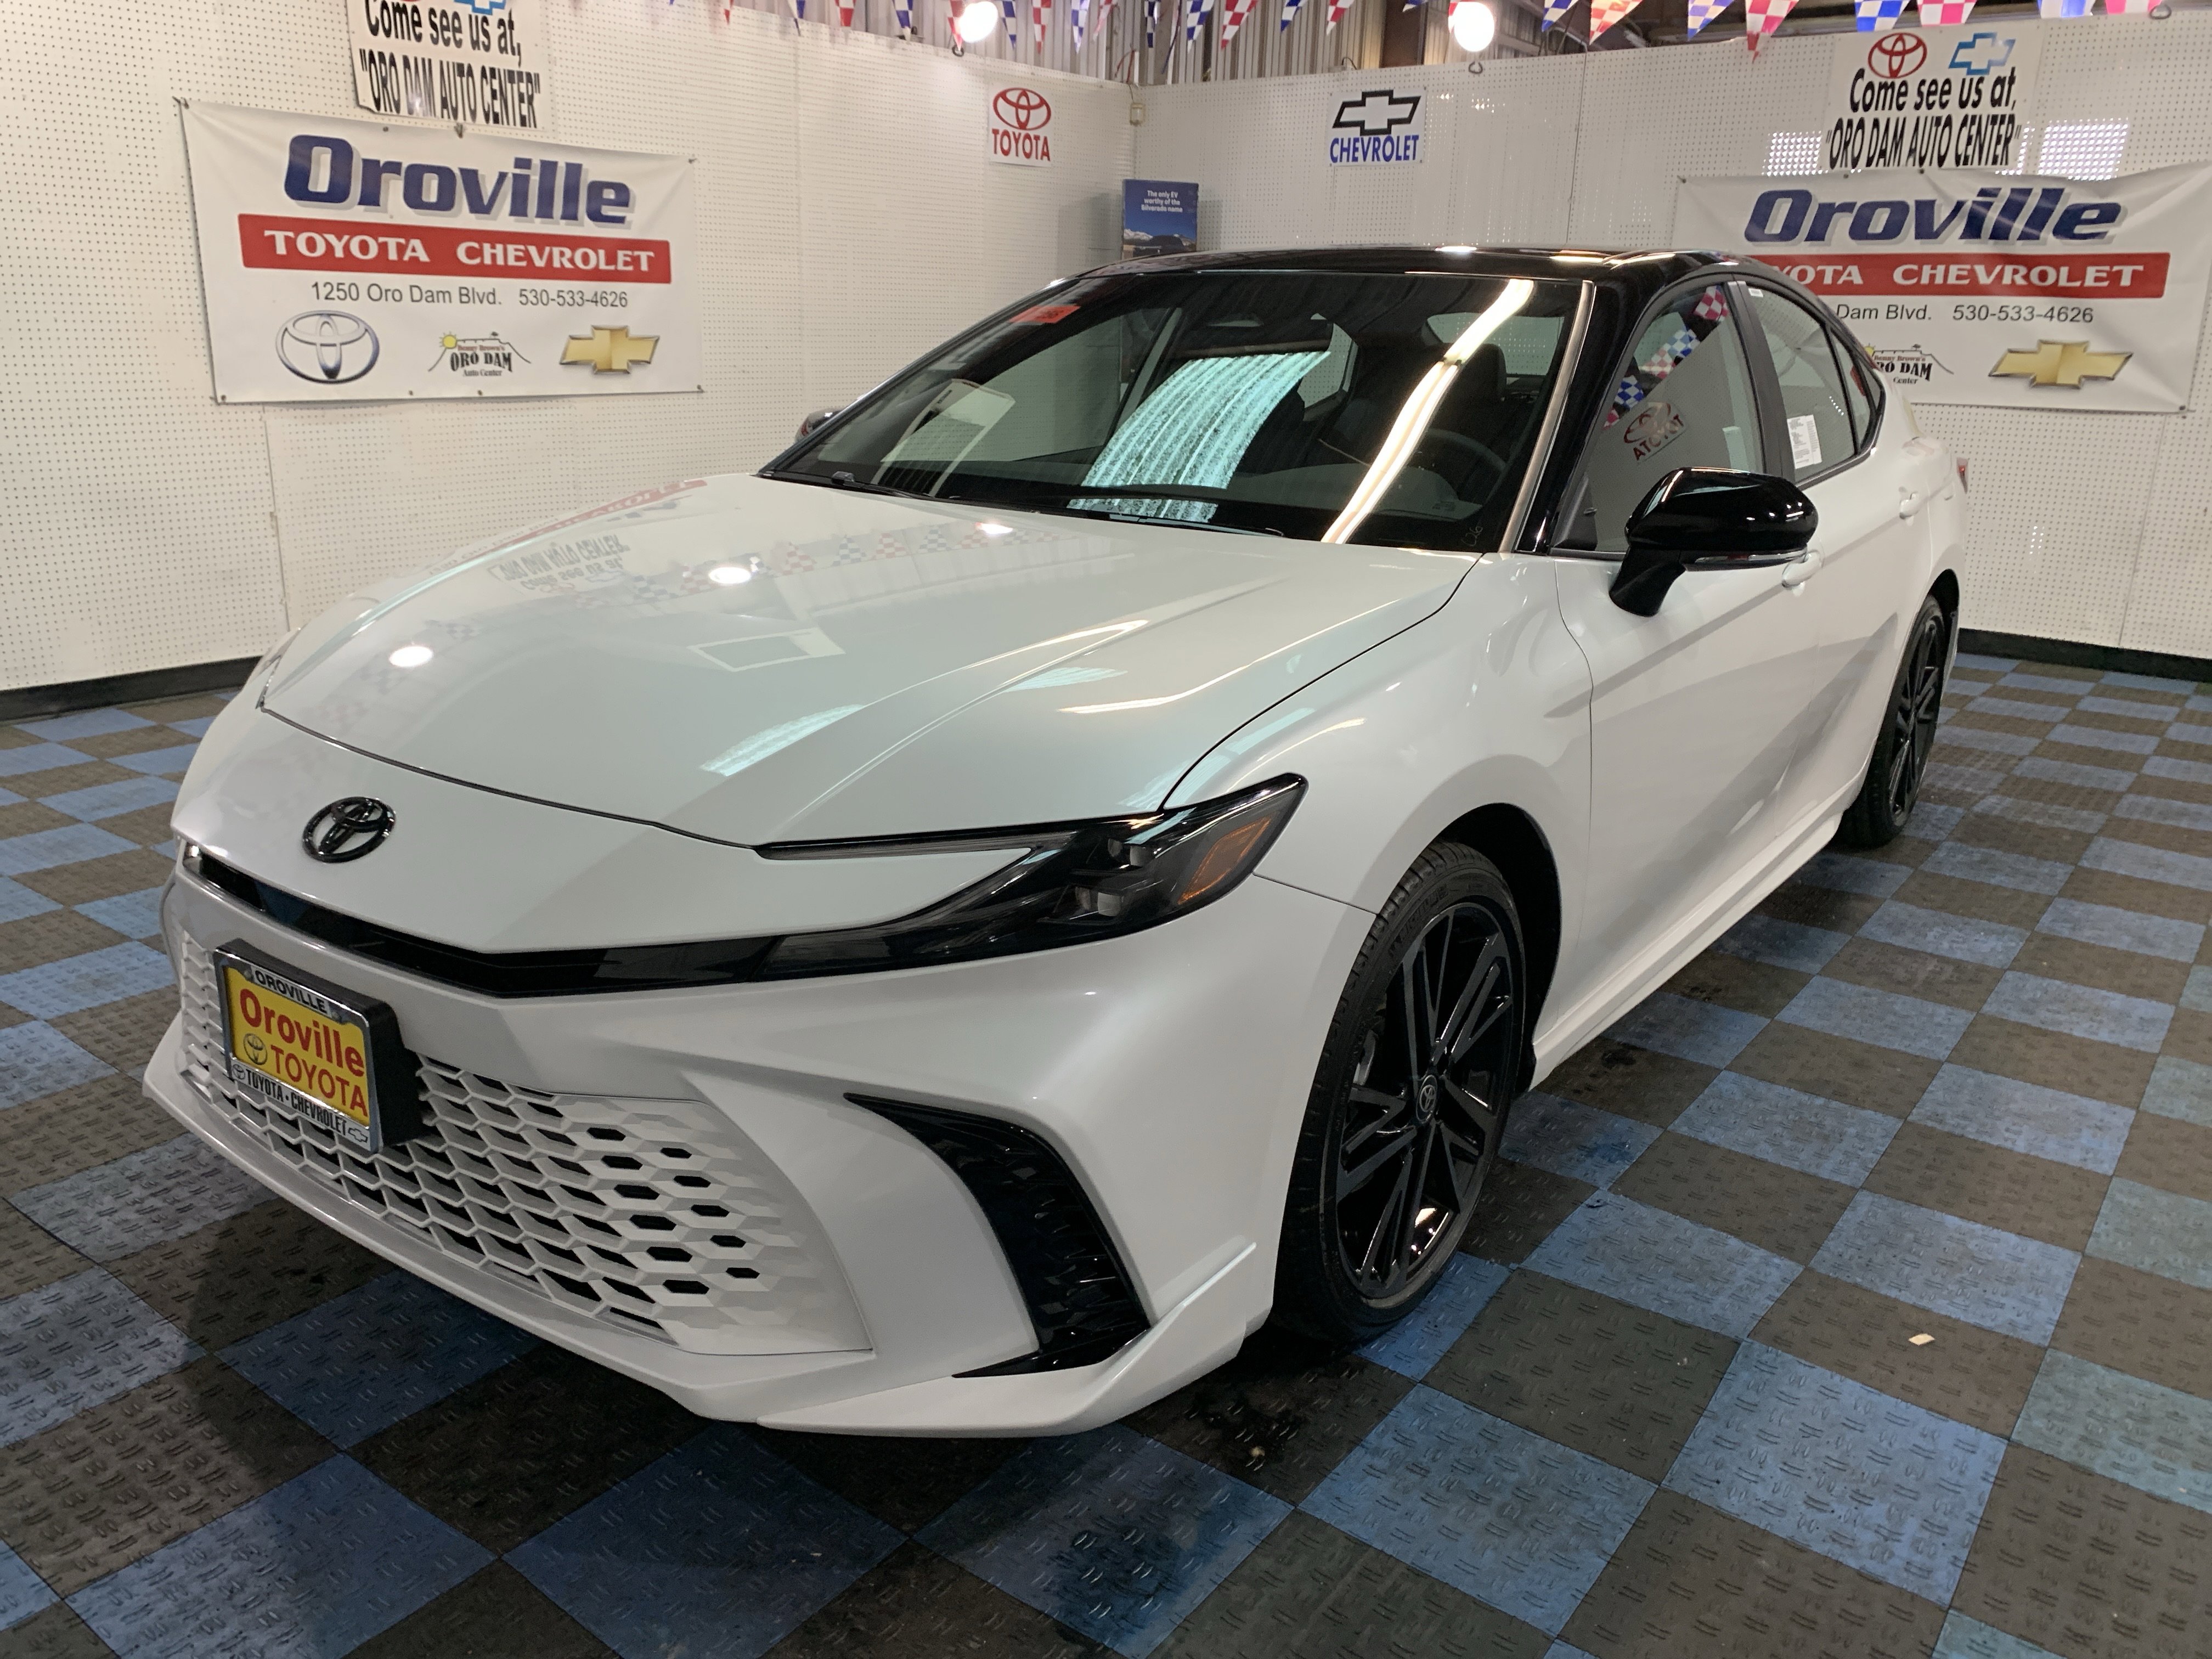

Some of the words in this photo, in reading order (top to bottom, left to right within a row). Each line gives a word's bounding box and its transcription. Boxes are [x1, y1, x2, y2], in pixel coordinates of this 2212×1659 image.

[365, 0, 422, 42] Come
[428, 7, 462, 48] see
[469, 14, 491, 52] us
[497, 8, 521, 67] at,
[359, 48, 400, 114] "ORO
[403, 55, 436, 117] DAM
[439, 60, 477, 123] AUTO
[481, 65, 540, 128] CENTER"
[1850, 68, 1909, 112] Come
[1914, 77, 1952, 110] see
[1958, 76, 1985, 109] us
[1990, 66, 2017, 111] at,
[991, 128, 1051, 162] TOYOTA
[1329, 134, 1419, 163] CHEVROLET
[1826, 117, 1865, 170] "ORO
[1866, 117, 1906, 167] DAM
[1906, 114, 1953, 168] AUTO
[1955, 114, 2022, 167] CENTER"
[284, 134, 632, 225] Oroville
[1158, 190, 1170, 199] only
[1744, 187, 2122, 244] Oroville
[264, 230, 430, 263] TOYOTA
[457, 241, 654, 272] CHEVROLET
[312, 281, 360, 301] 1250
[368, 284, 403, 302] Oro
[410, 285, 452, 304] Dam
[459, 287, 502, 305] Blvd.
[519, 289, 628, 308] 530-533-4626
[1893, 264, 2144, 287] CHEVROLET
[1836, 304, 1878, 320] Dam
[1886, 304, 1932, 320] Blvd.
[1953, 304, 2094, 323] 530-533-4626
[450, 352, 479, 371] ORO
[484, 352, 512, 373] DAM
[1900, 363, 1933, 381] DAM
[255, 970, 328, 1014] OROVILLE
[240, 989, 365, 1077] Oroville
[245, 1068, 284, 1102] TOYOTA
[290, 1092, 347, 1137] CHEVROLET
[271, 1045, 368, 1117] TOYOTA
